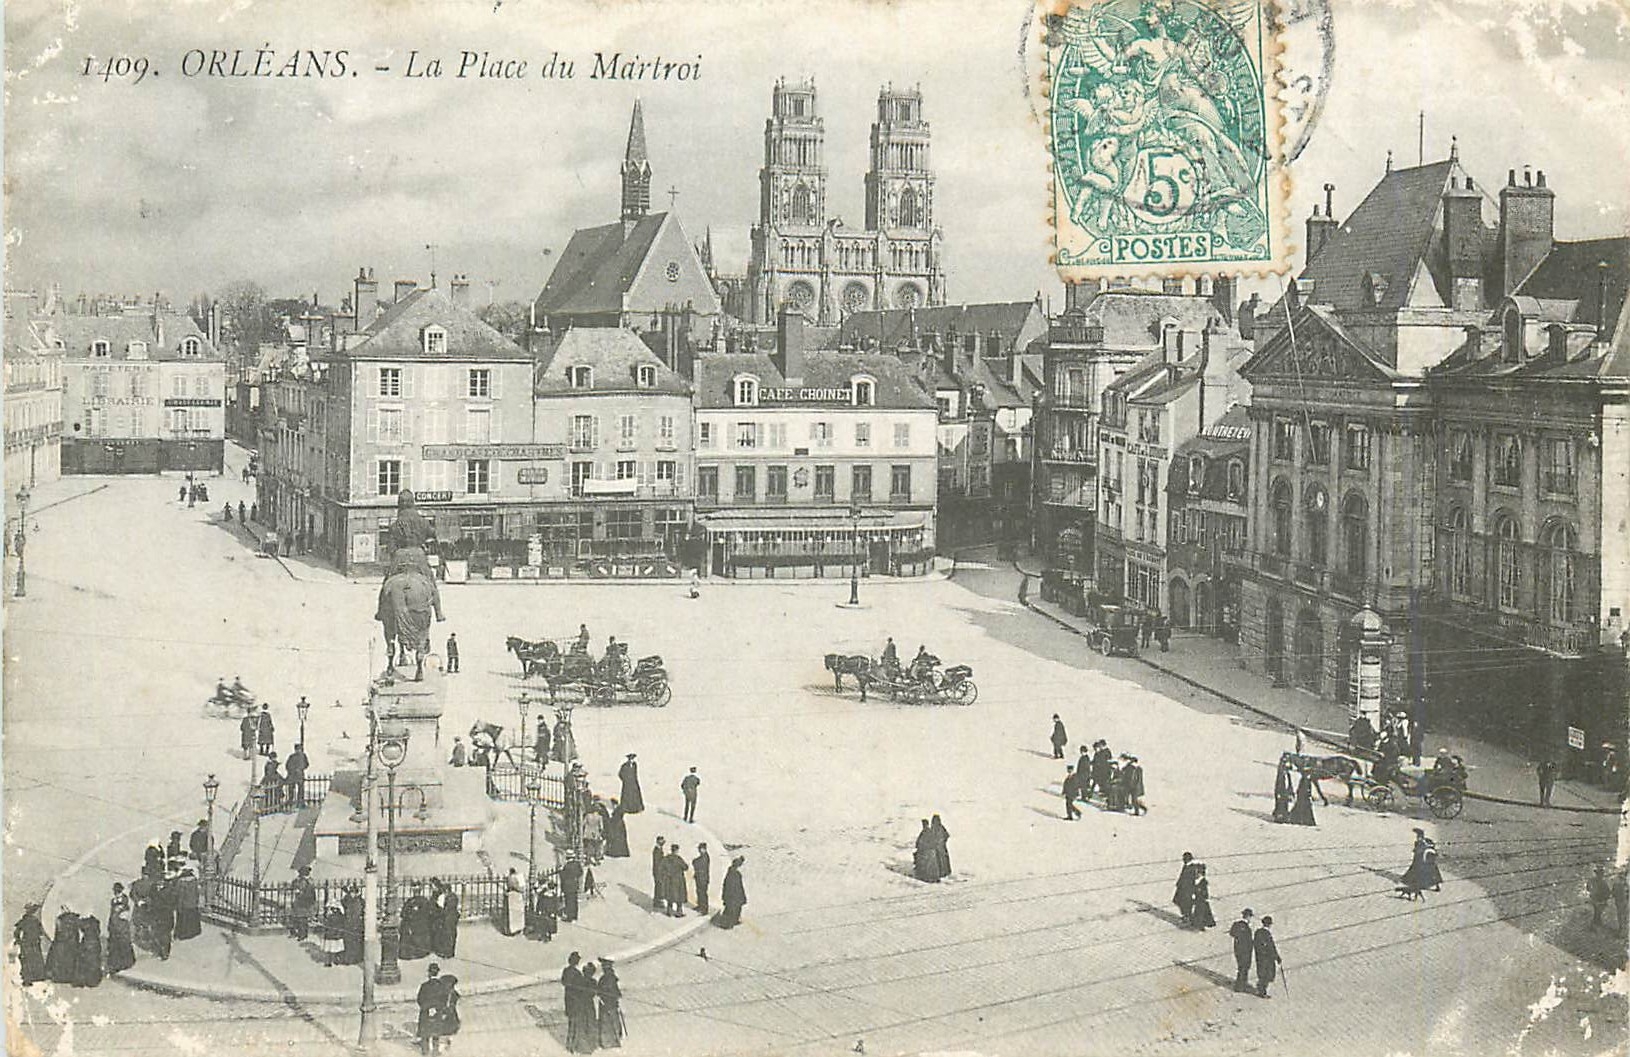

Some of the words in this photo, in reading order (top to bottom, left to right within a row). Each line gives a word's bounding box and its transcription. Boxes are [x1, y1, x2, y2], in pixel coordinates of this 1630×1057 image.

[1116, 235, 1208, 260] POSTES
[82, 365, 154, 373] PAPETERIE
[759, 388, 793, 400] CAFE
[799, 388, 852, 400] CHOINET
[82, 396, 155, 407] LIBRAIRIE
[416, 491, 452, 501] CONCERT
